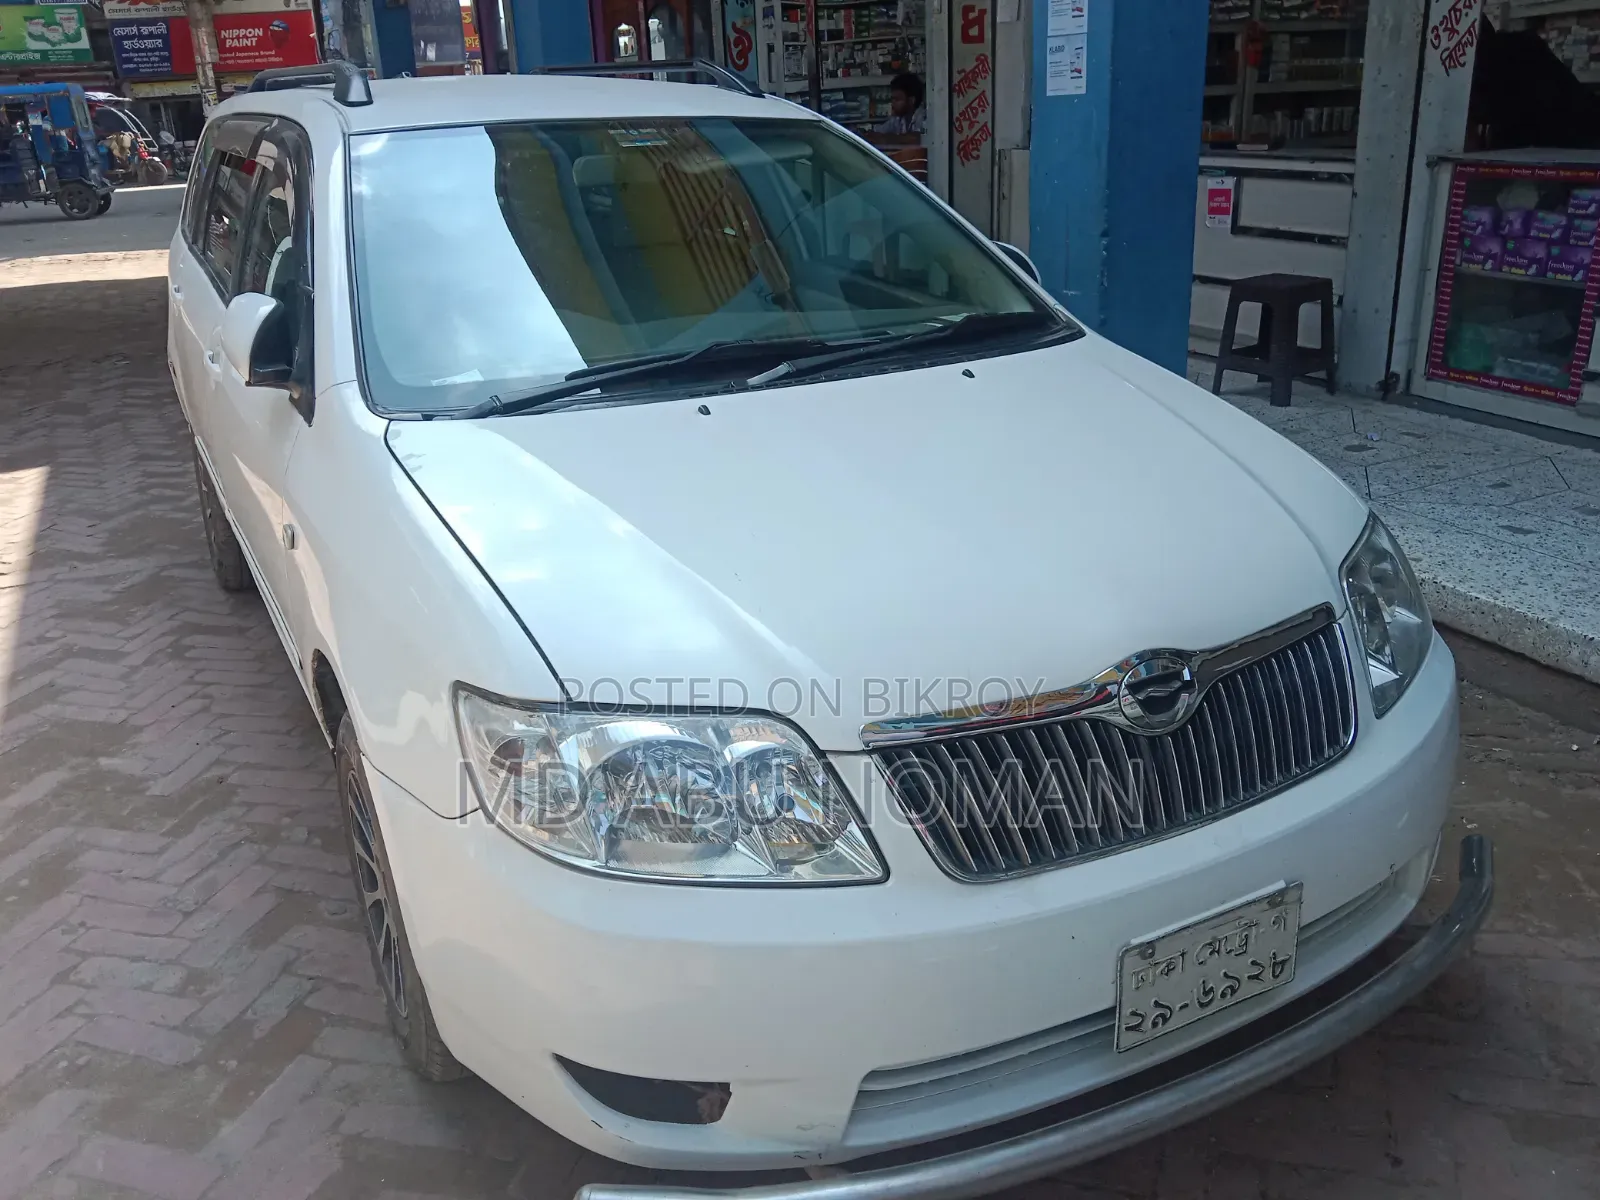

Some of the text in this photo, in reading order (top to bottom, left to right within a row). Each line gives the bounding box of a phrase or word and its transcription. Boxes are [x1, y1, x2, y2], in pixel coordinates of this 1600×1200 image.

[221, 28, 263, 38] NIPPON
[226, 38, 258, 48] PAINT
[1132, 947, 1187, 990] ঢাকা
[1124, 950, 1292, 1033] ২৯-৬৯২৮
